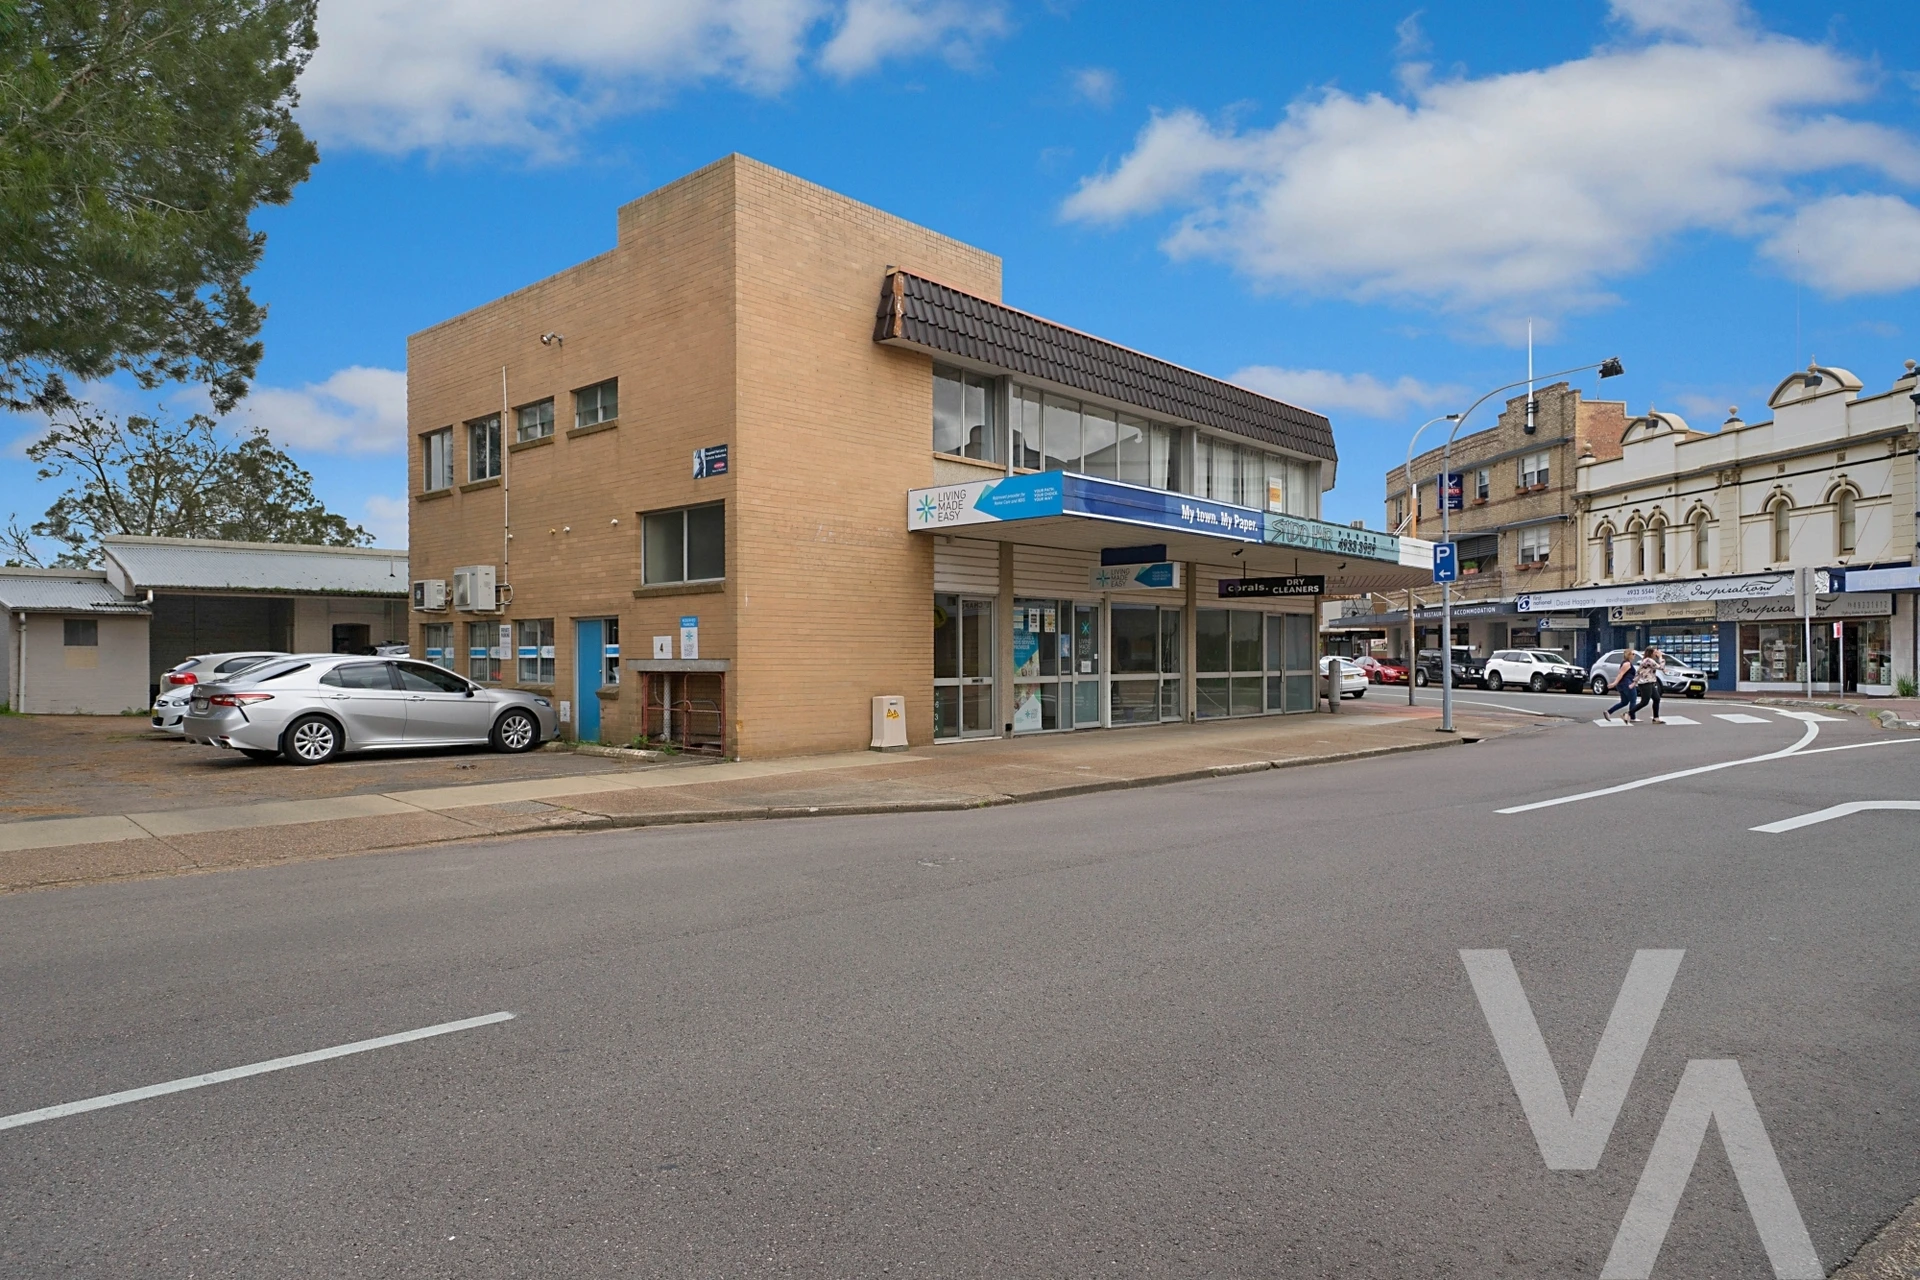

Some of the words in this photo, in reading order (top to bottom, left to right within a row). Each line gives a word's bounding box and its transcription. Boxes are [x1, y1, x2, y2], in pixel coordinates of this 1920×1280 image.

[938, 489, 966, 502] LIVING
[938, 500, 963, 511] MADE
[938, 510, 961, 522] EASY
[1181, 504, 1194, 524] My
[1196, 507, 1218, 525] town.
[1220, 511, 1233, 530] My
[1234, 514, 1258, 533] Paper.
[1272, 518, 1310, 545] STUDIO
[1312, 525, 1334, 550] HAIR
[1436, 546, 1450, 563] P
[1272, 585, 1319, 594] CLEANERS
[1691, 580, 1776, 600] Inspirations
[1572, 598, 1596, 606] Haggarty
[1454, 607, 1496, 616] ACCOMMODATION
